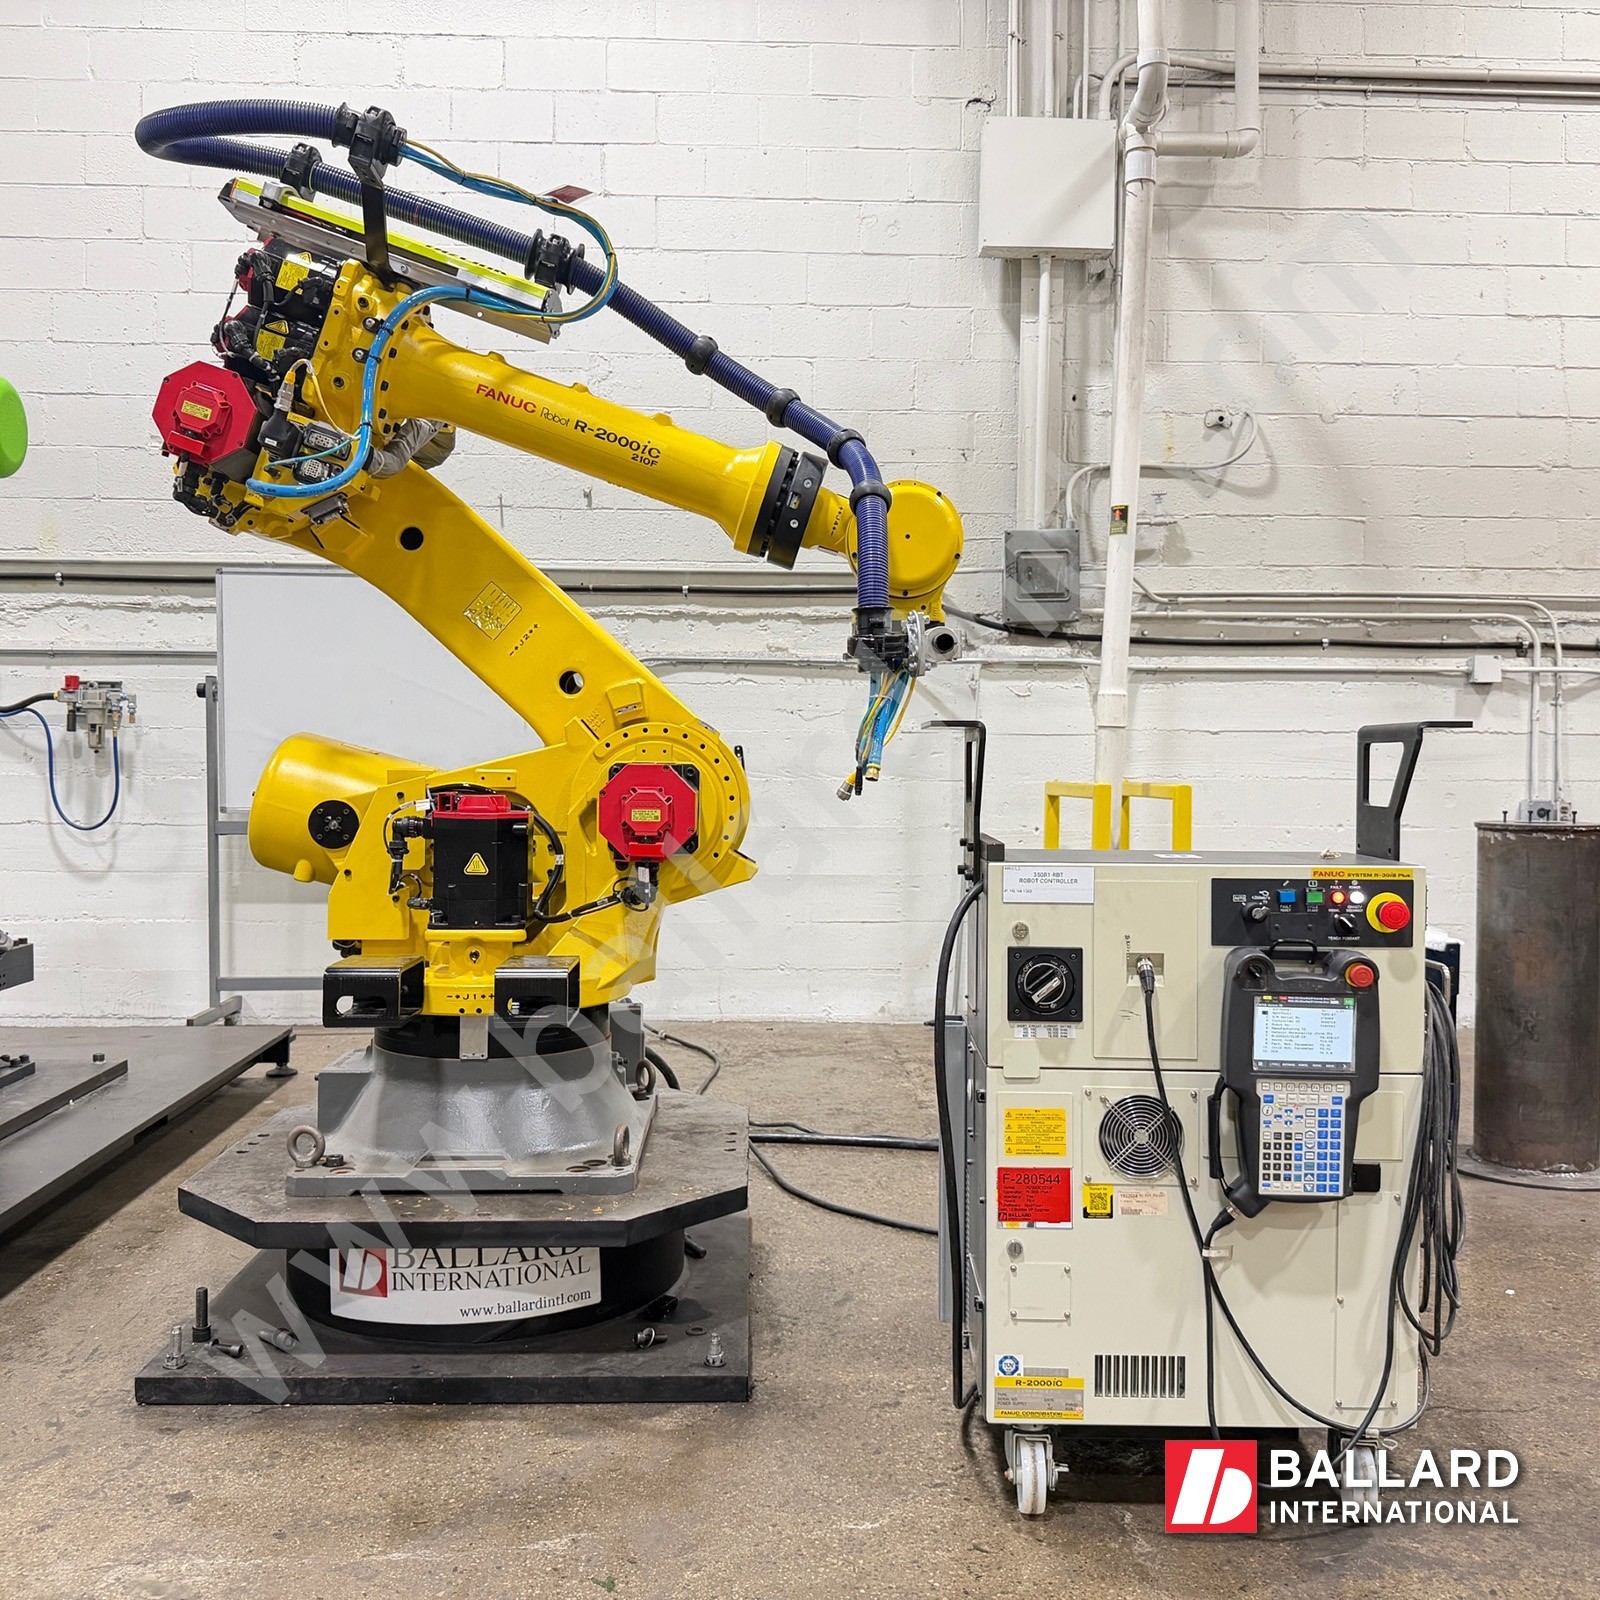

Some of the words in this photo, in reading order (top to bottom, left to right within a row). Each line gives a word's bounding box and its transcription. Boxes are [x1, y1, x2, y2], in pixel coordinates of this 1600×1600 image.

[476, 384, 537, 414] FANUC
[540, 406, 570, 427] Robot
[574, 419, 661, 459] R-2000iC
[631, 453, 659, 468] 210F
[1313, 870, 1345, 878] FANUC
[1002, 1173, 1061, 1184] F-280544
[391, 1255, 592, 1292] INTERNATIONAL
[460, 1289, 592, 1318] www.ballardintl.com
[1016, 1378, 1062, 1386] R-2000iC
